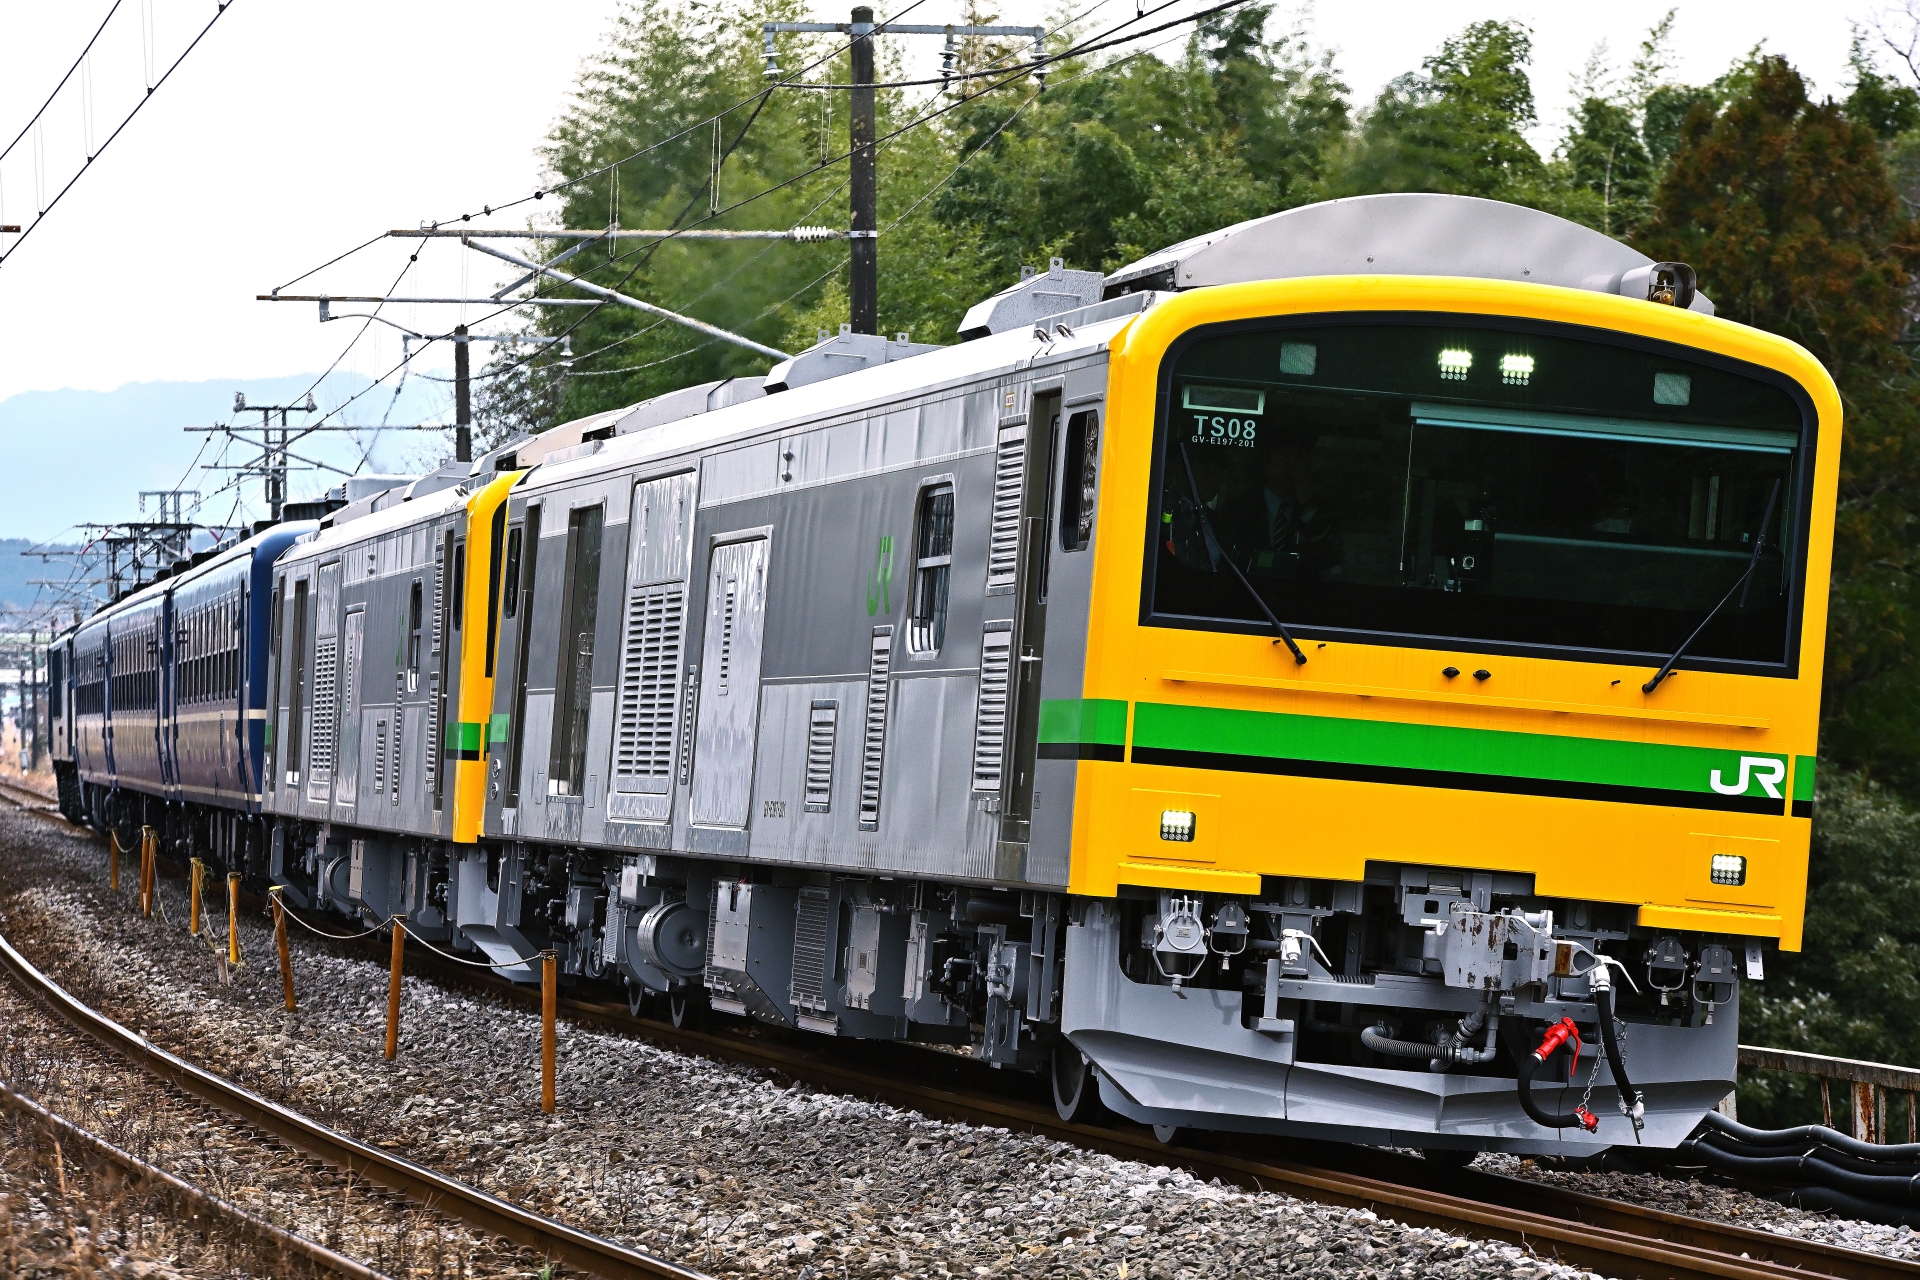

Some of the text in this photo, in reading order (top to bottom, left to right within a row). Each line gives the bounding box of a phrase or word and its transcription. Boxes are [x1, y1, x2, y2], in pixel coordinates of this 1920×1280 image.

[1191, 435, 1255, 448] GV-E197-201
[1193, 415, 1256, 440] TS08
[866, 535, 894, 617] JR
[1710, 755, 1785, 799] JR
